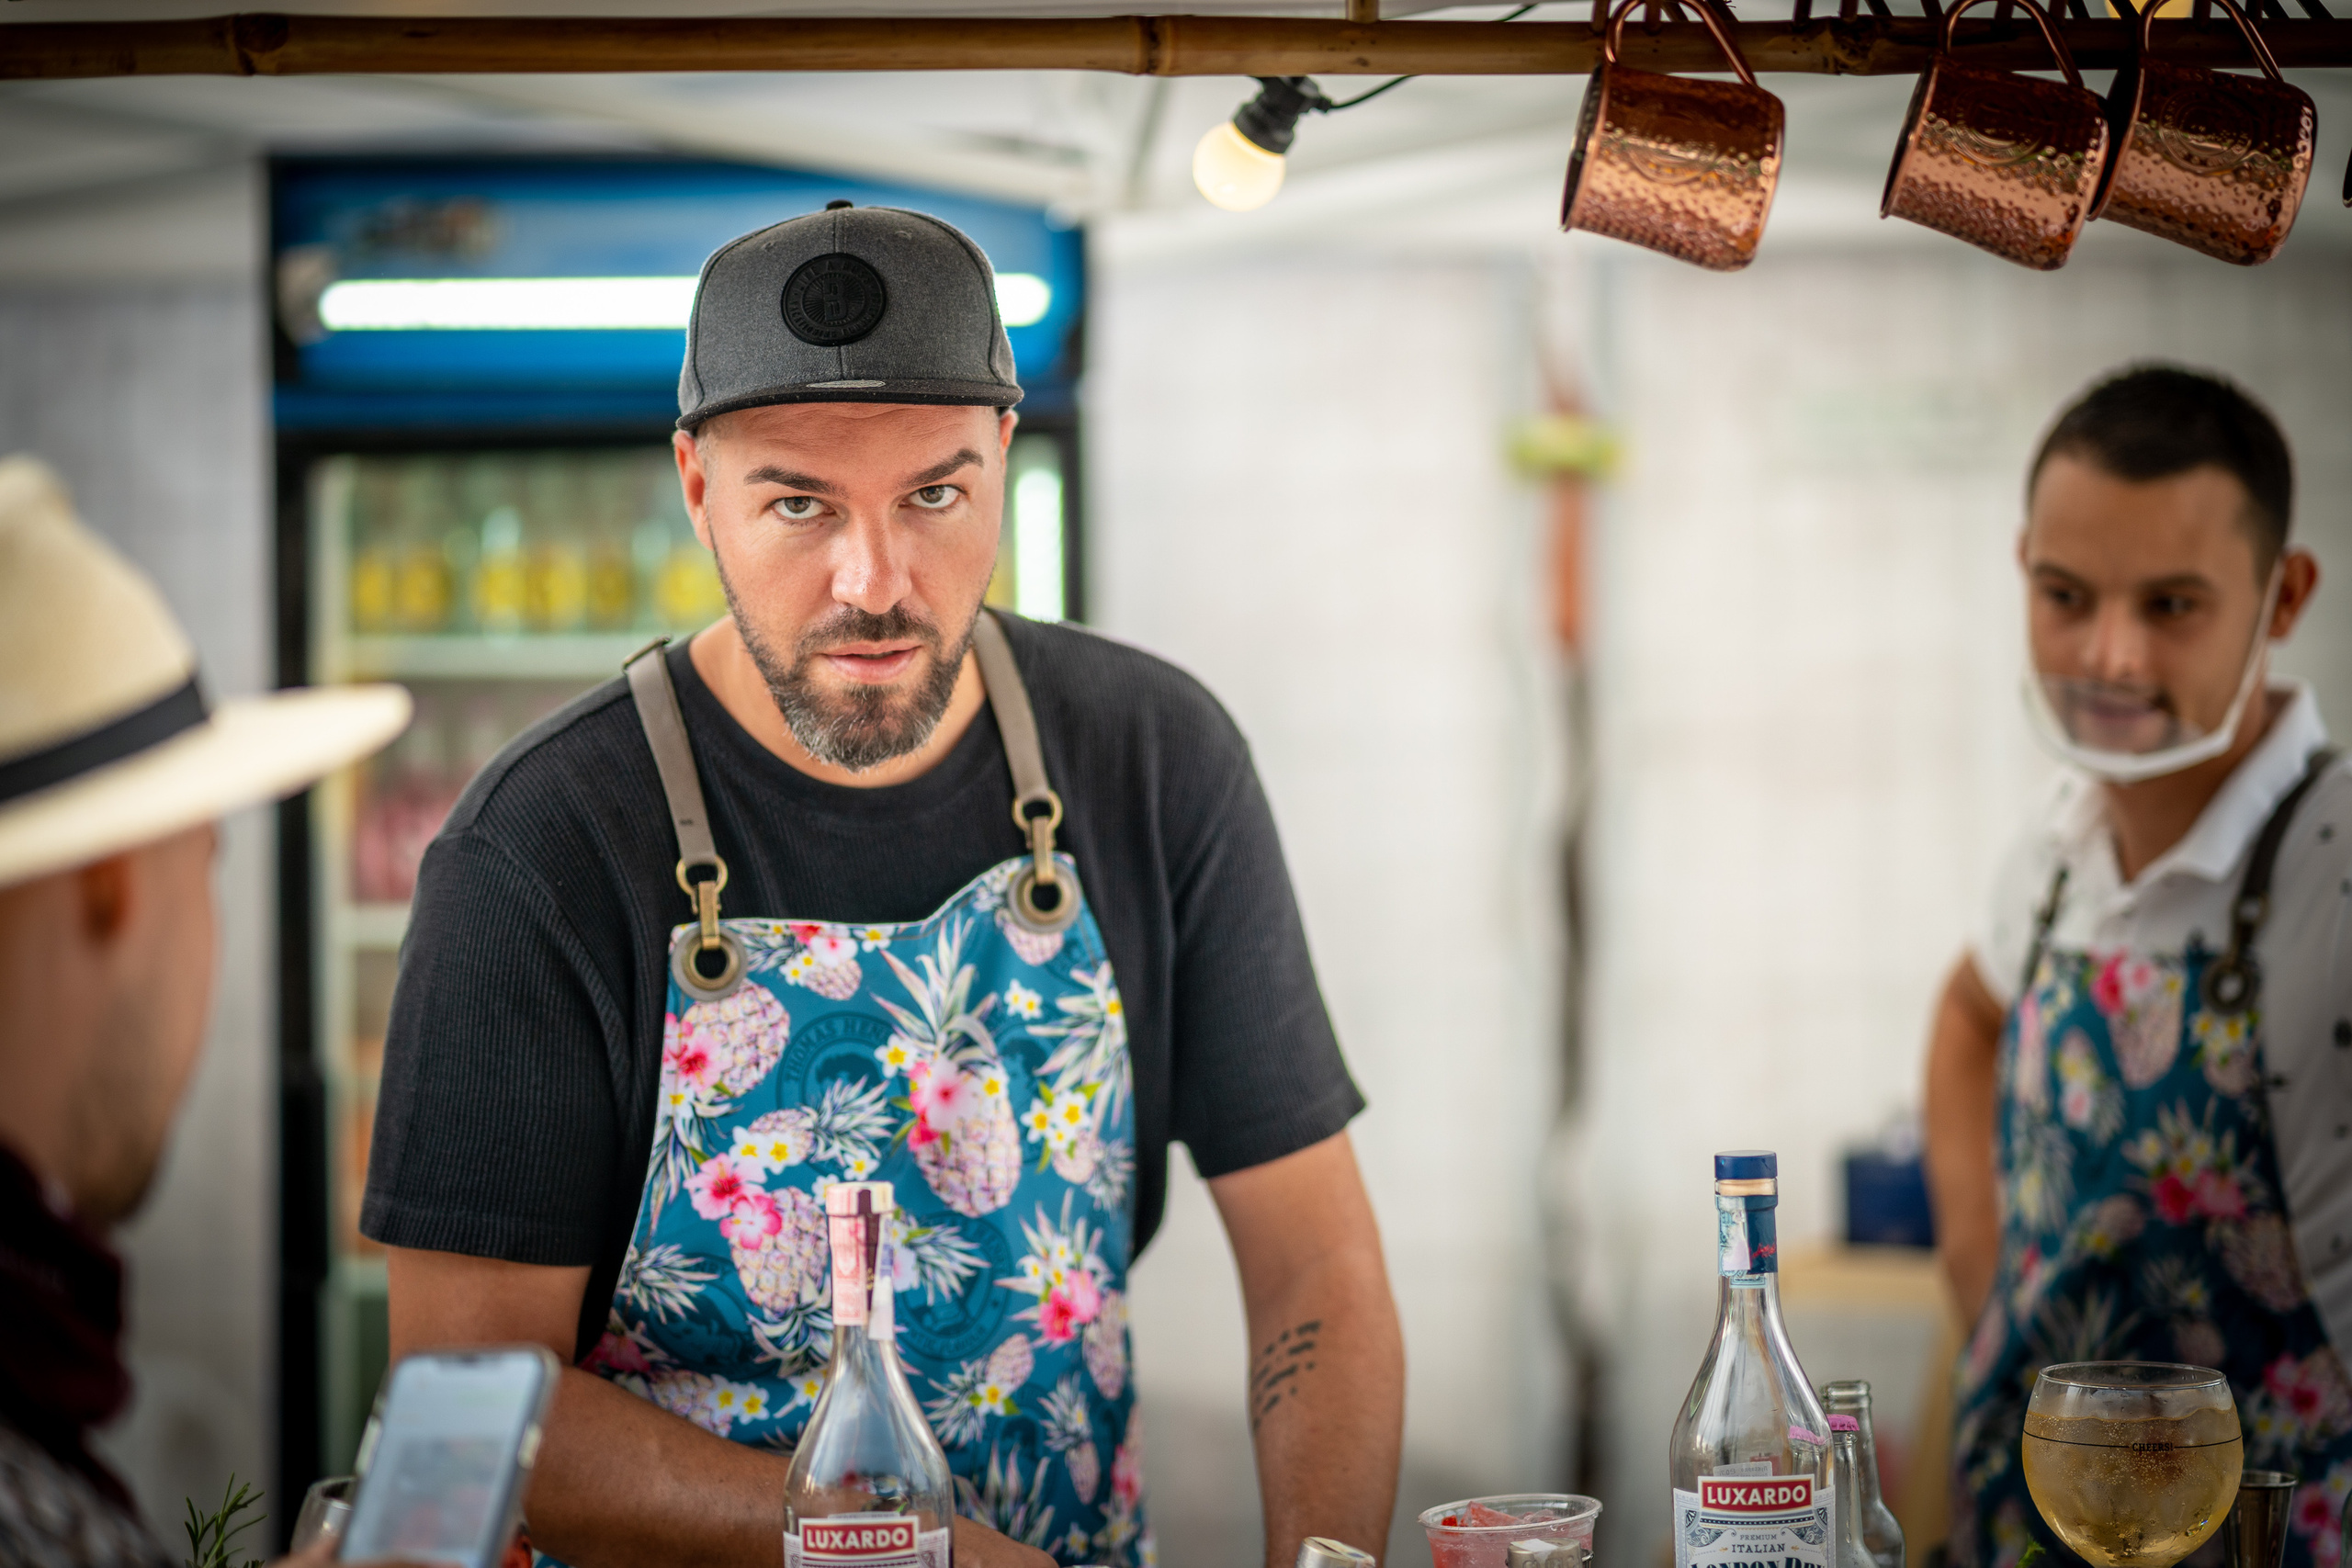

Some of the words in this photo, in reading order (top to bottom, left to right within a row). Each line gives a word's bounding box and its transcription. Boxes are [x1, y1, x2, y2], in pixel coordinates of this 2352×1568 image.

[2132, 1442, 2174, 1452] CHEERS!
[1706, 1484, 1807, 1506] LUXARDO
[805, 1527, 910, 1551] LUXARDO
[1731, 1543, 1786, 1554] ITALIAN
